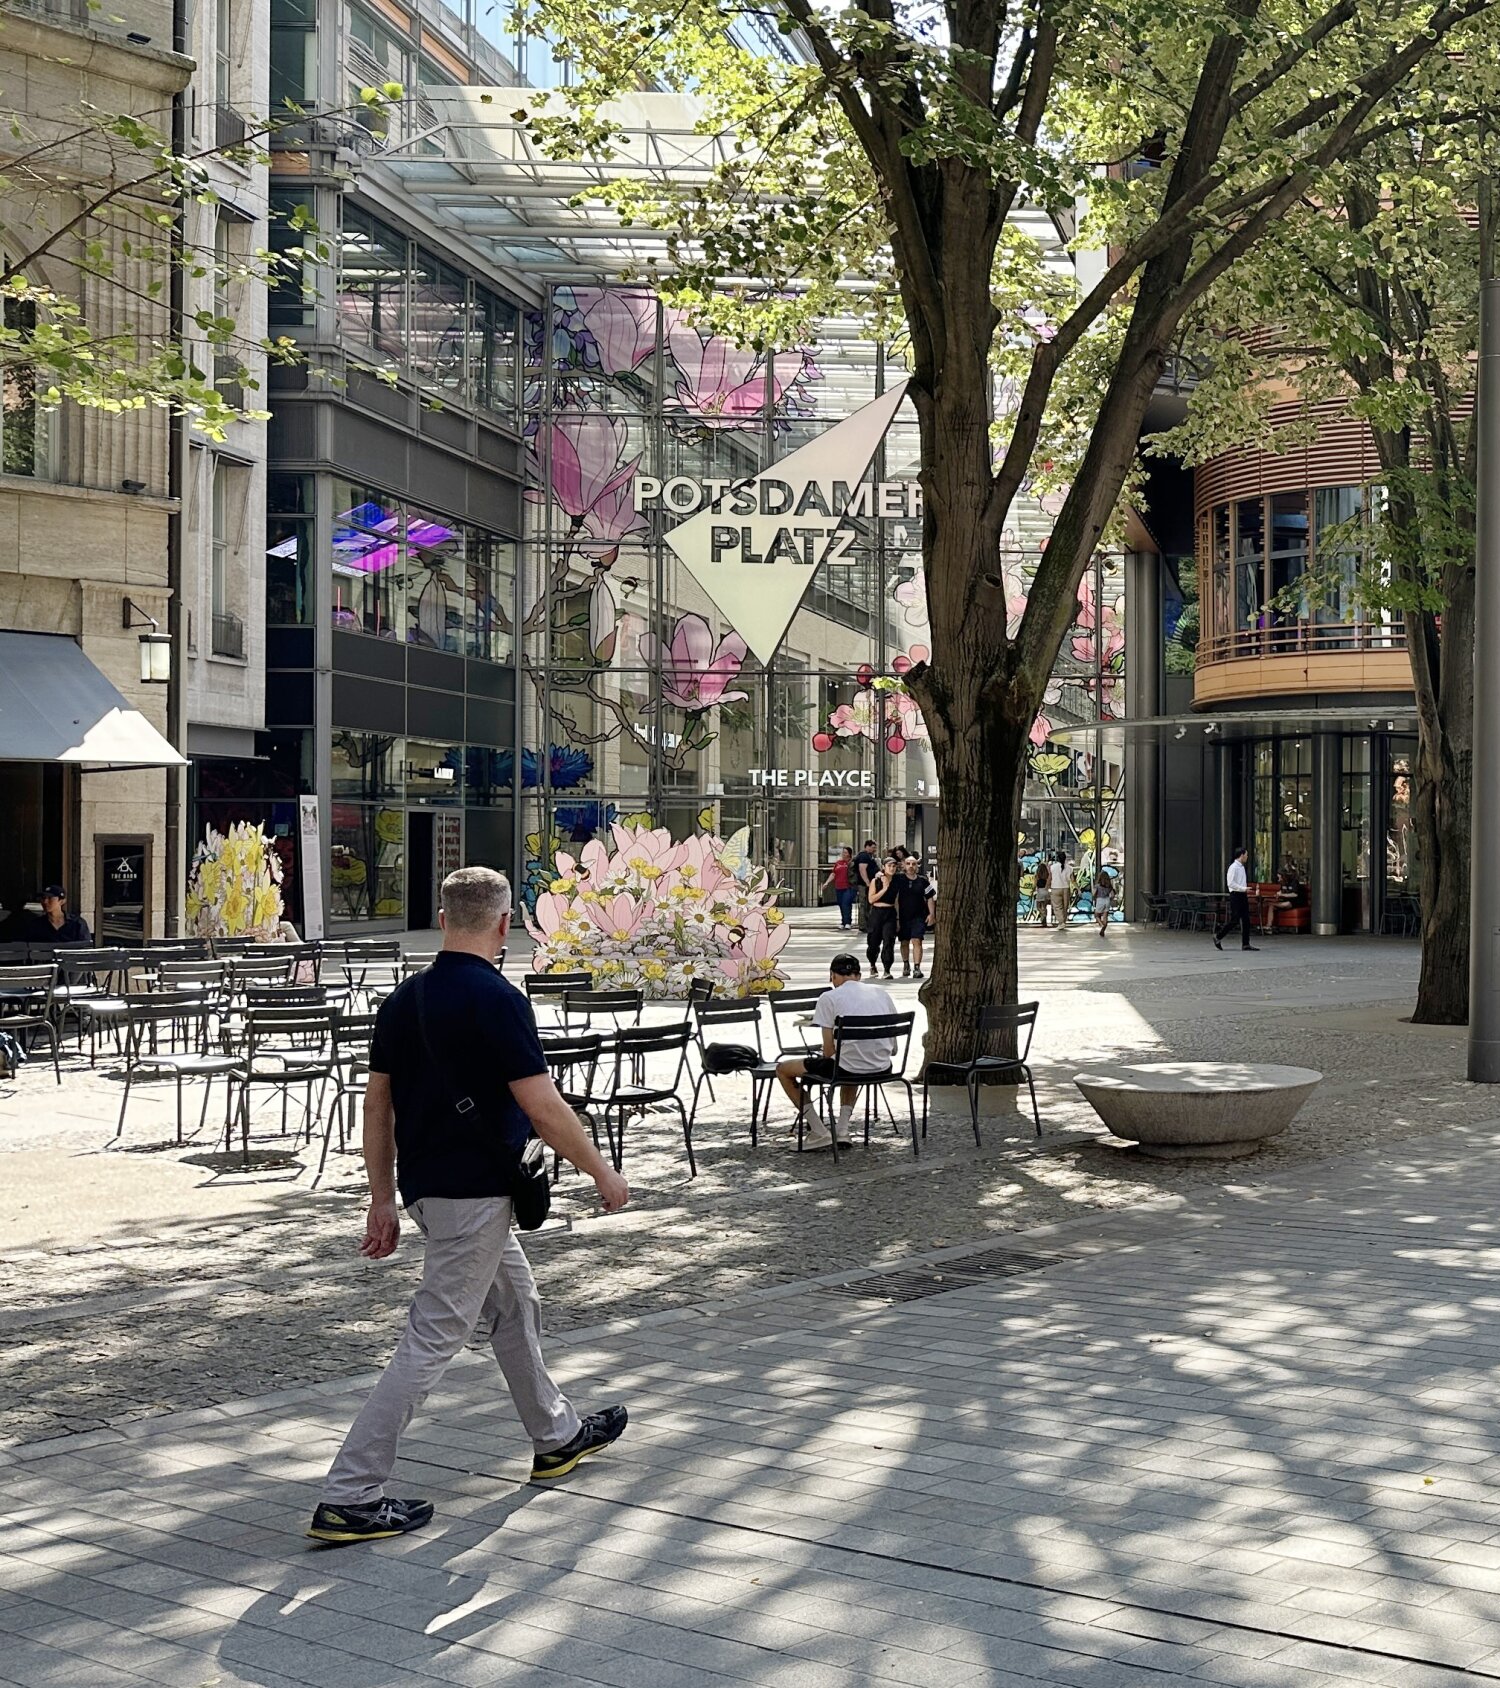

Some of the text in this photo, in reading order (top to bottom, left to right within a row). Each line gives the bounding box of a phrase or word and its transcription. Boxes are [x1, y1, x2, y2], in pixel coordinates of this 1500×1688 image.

[711, 525, 857, 565] PLATZ
[748, 769, 871, 787] THE PLAYCE
